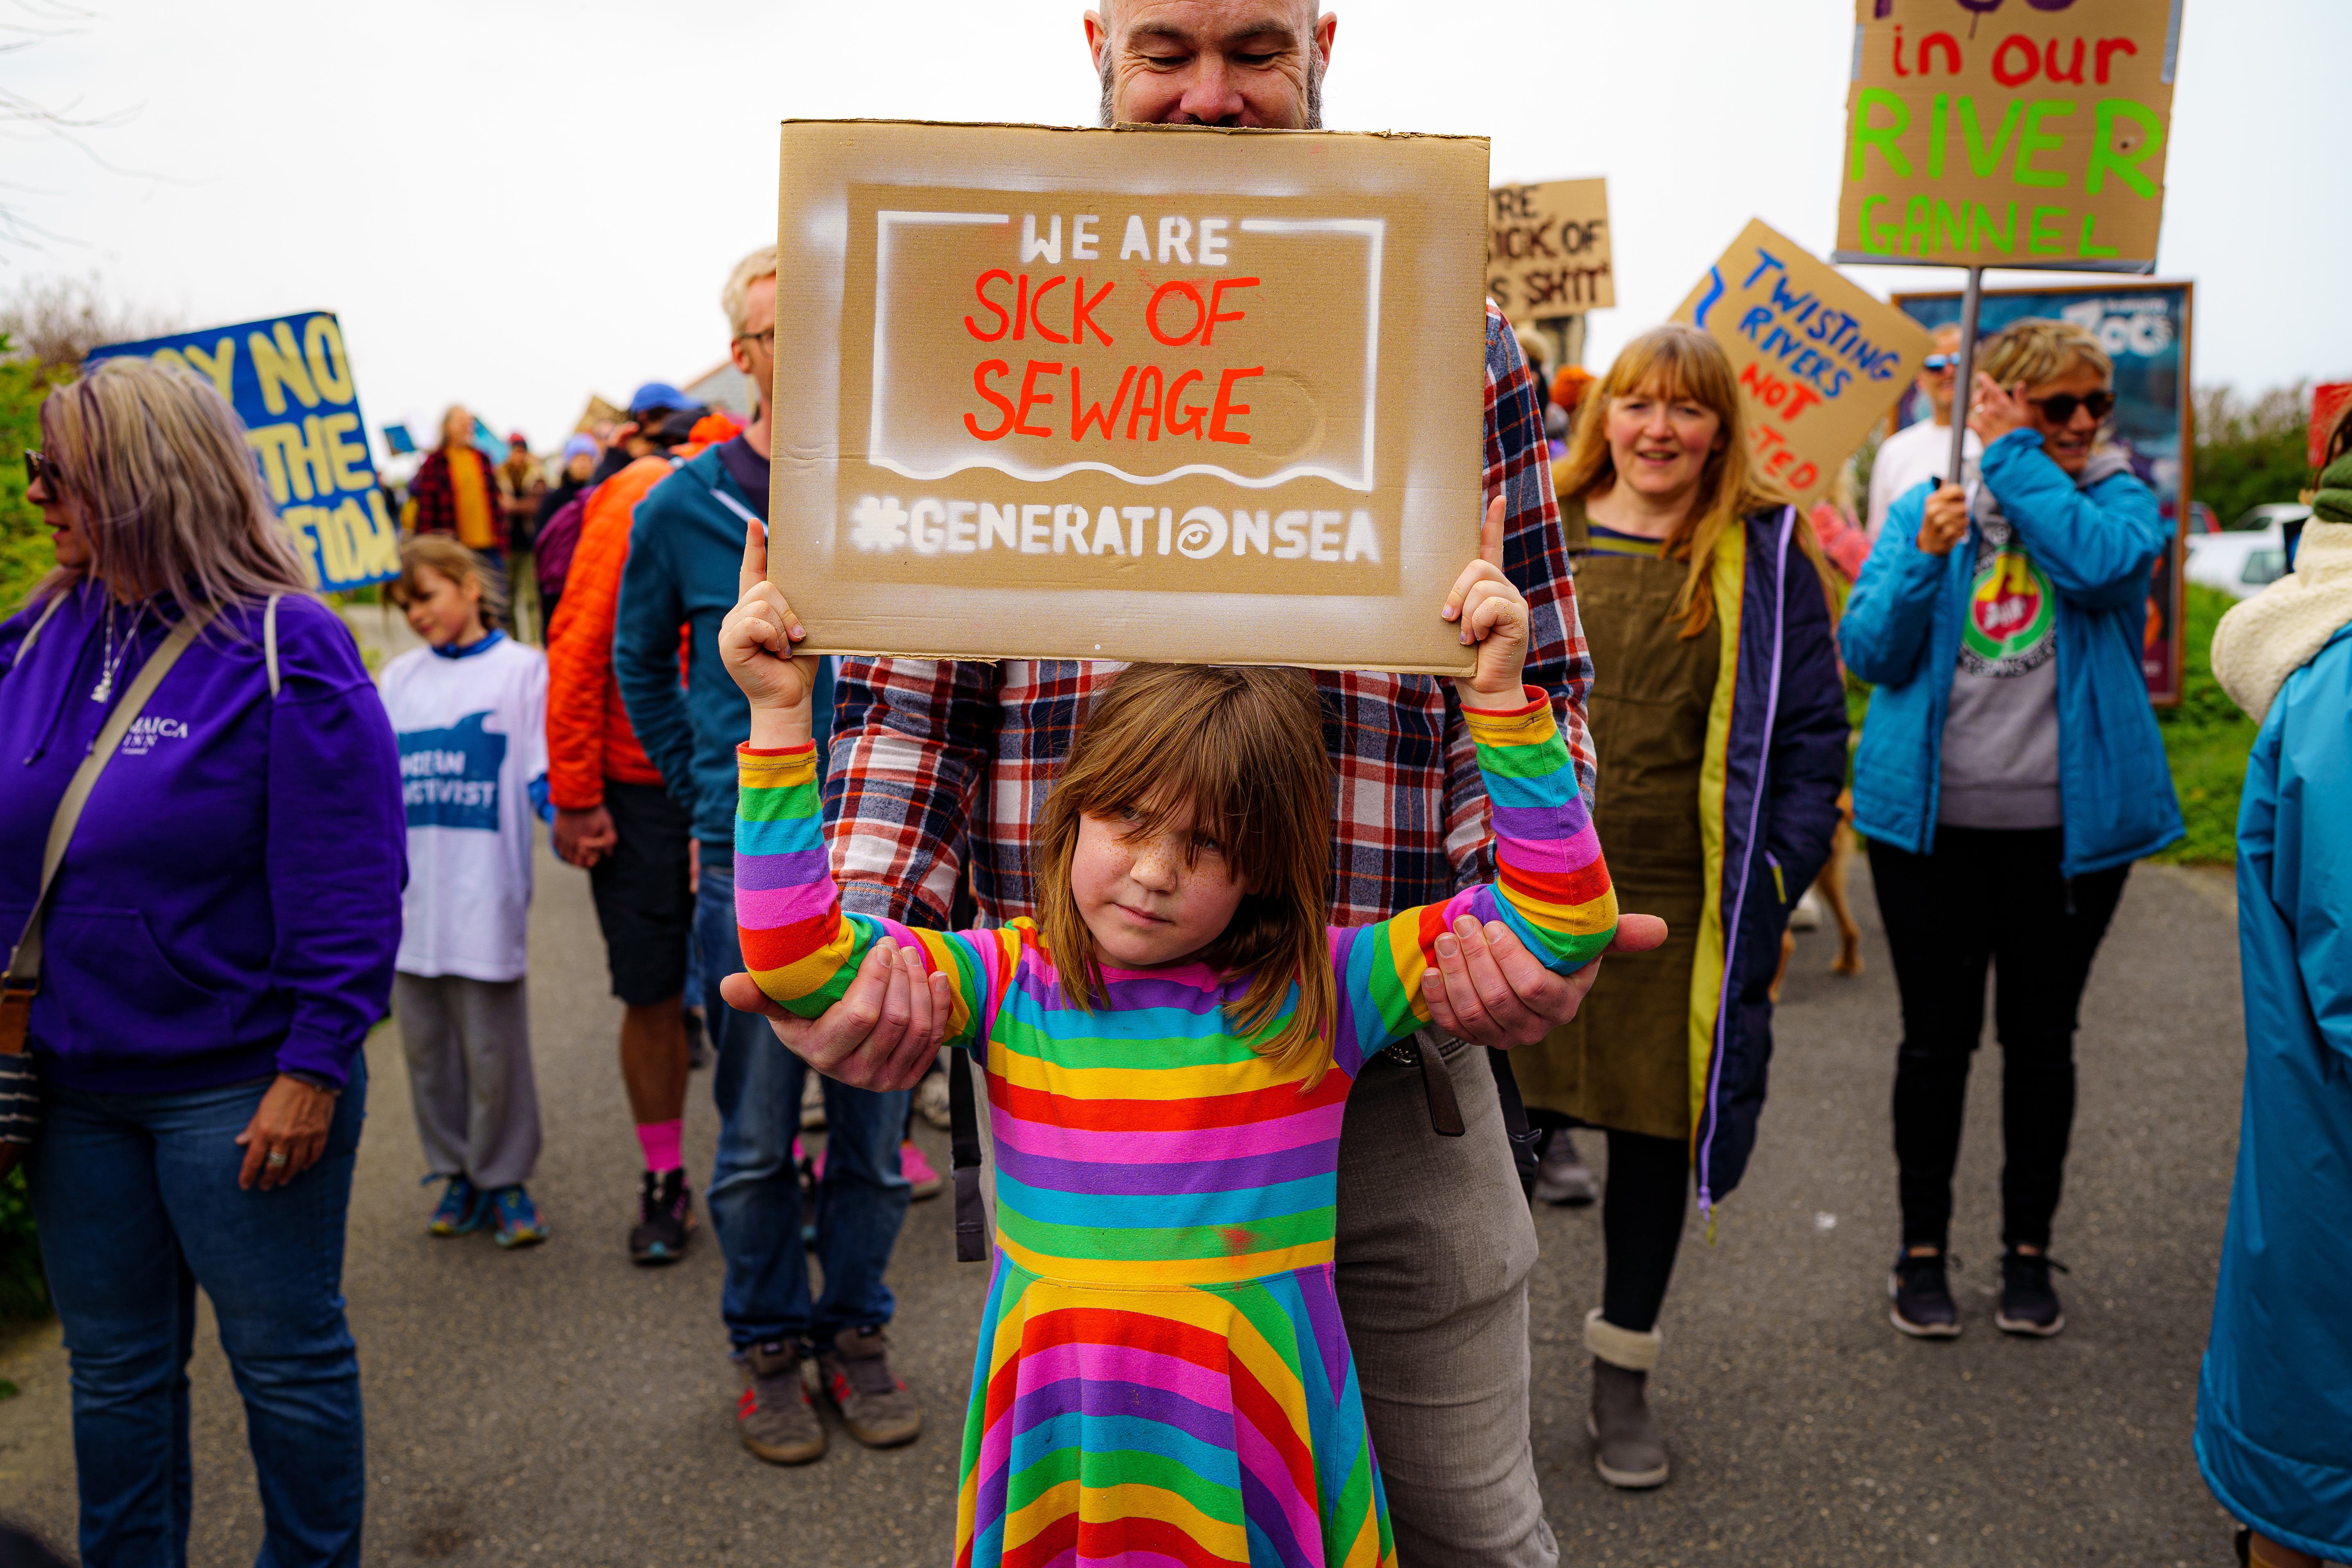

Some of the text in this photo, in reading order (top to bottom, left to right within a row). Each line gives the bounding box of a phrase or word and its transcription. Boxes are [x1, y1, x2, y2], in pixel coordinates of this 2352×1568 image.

[1893, 24, 2137, 88] in our
[1850, 86, 2164, 199] RIVER
[1021, 213, 1228, 266] WE ARE
[1488, 213, 1606, 260] ICK OF
[1858, 194, 2119, 258] GANNEL
[964, 269, 1261, 347] SICK OF
[1742, 246, 1900, 382] TWISTING
[247, 314, 355, 416] NO
[1737, 306, 1853, 400] RIVERS
[1738, 361, 1823, 423] NOT
[963, 359, 1264, 445] SEWAGE
[245, 411, 374, 504] THE
[1750, 423, 1818, 490] TED
